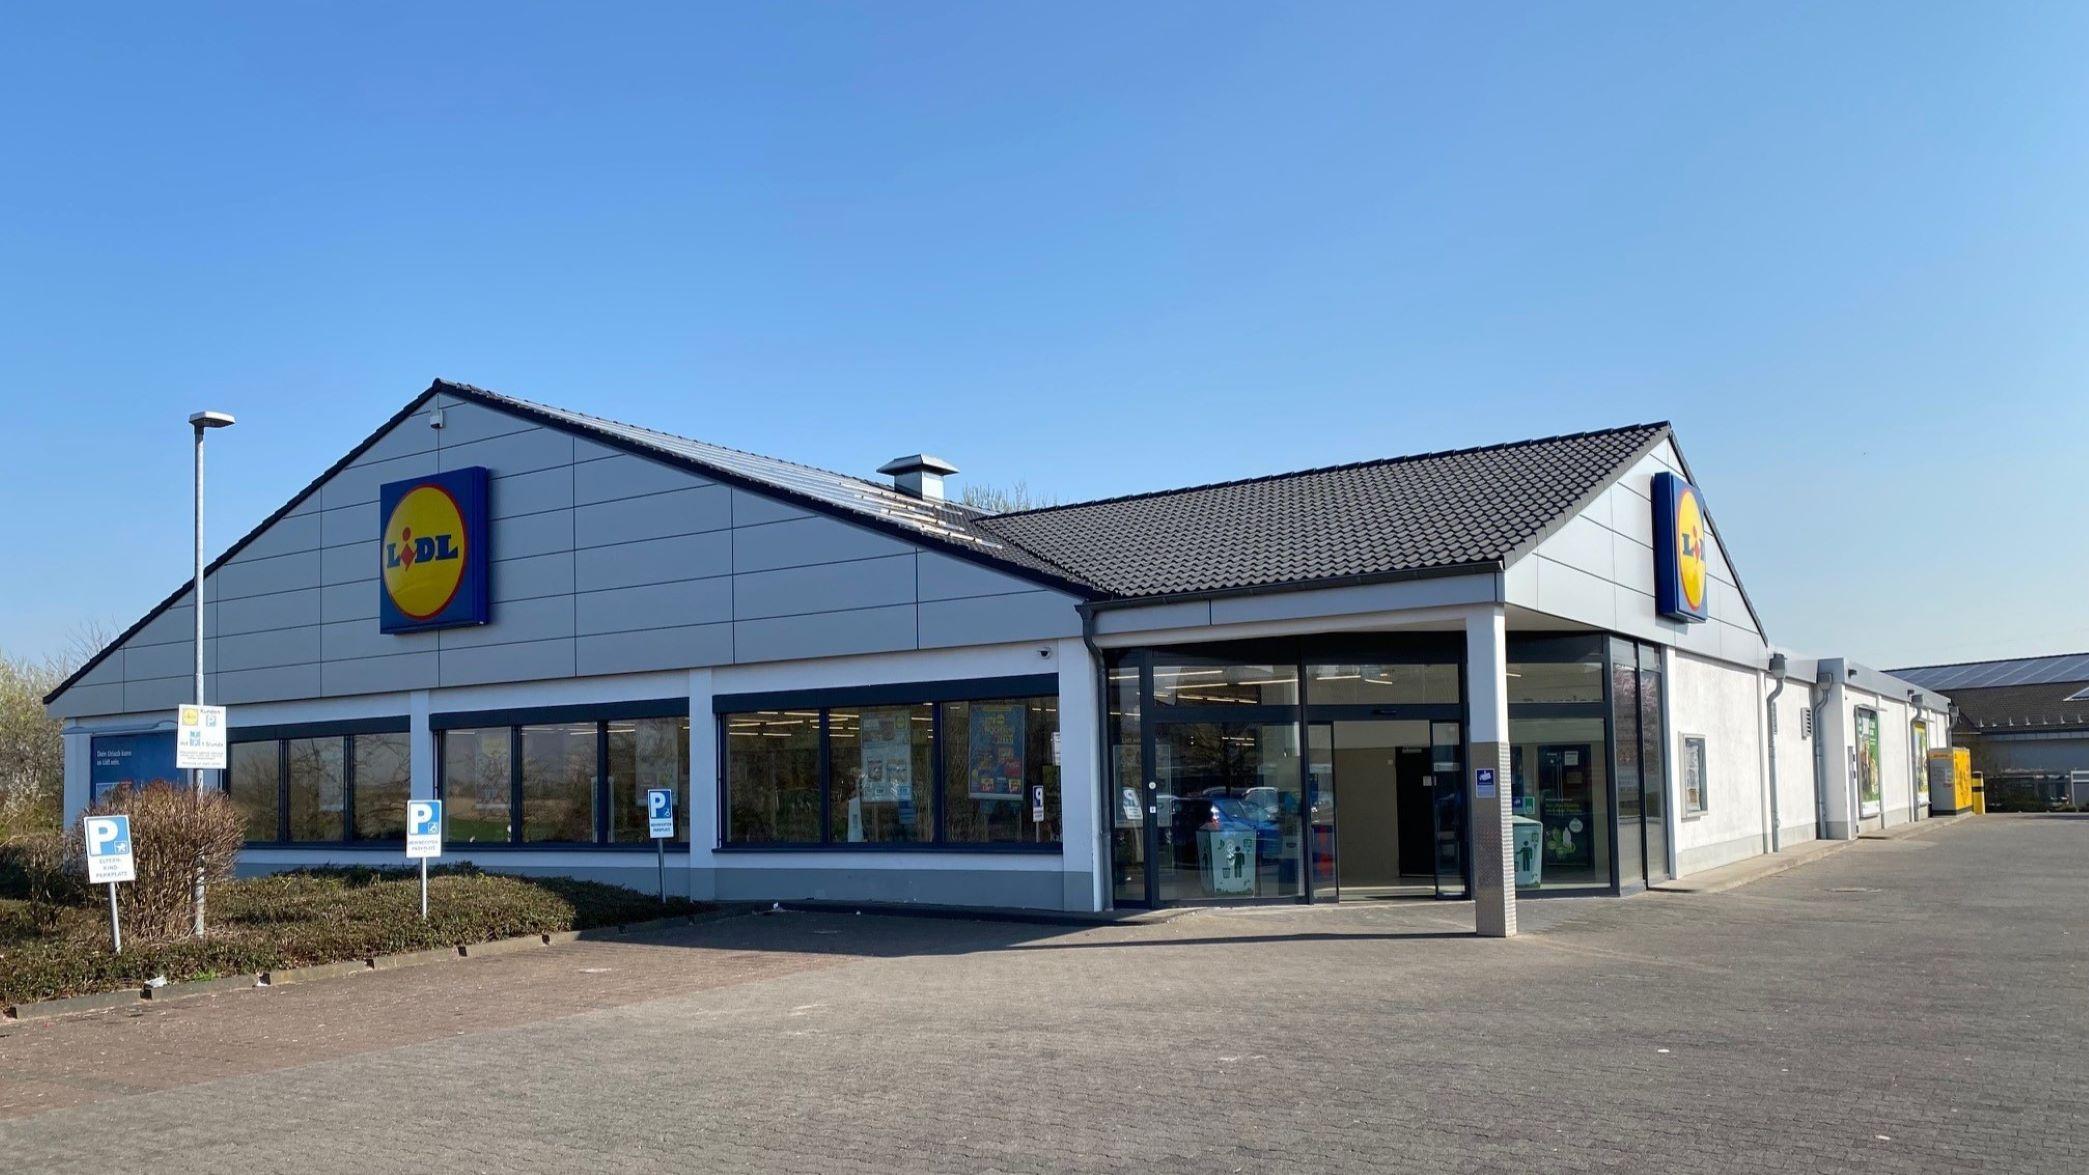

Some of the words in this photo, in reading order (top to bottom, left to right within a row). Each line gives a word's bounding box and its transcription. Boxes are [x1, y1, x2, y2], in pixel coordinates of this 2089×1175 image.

[410, 804, 432, 834] P
[650, 792, 666, 817] P
[88, 820, 118, 854] P
